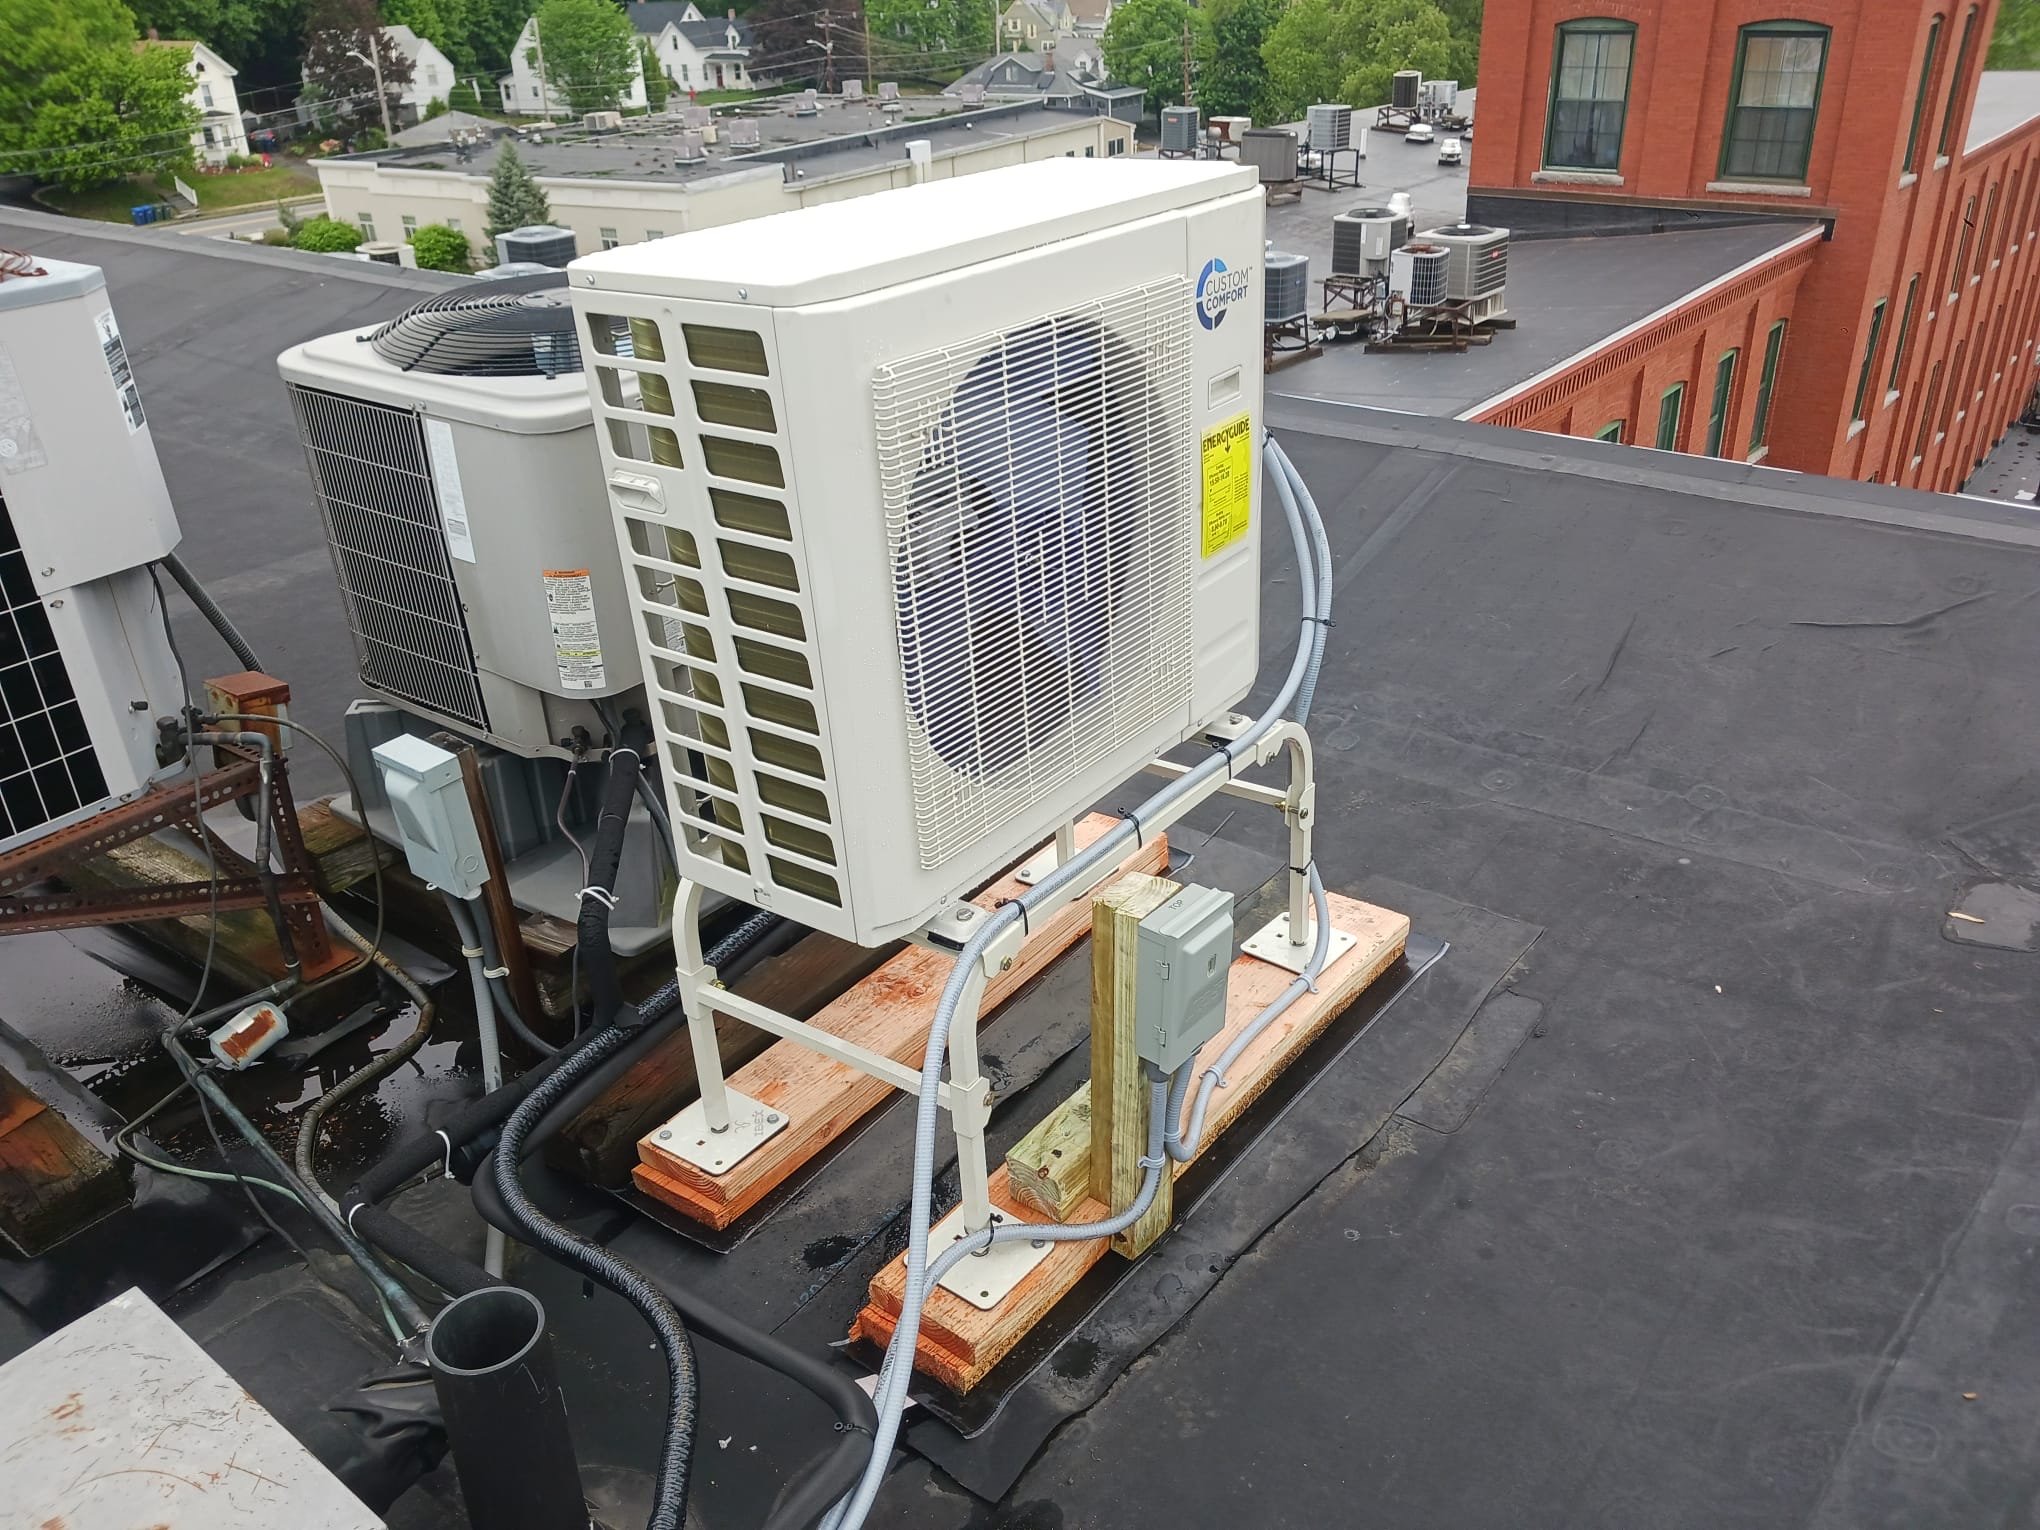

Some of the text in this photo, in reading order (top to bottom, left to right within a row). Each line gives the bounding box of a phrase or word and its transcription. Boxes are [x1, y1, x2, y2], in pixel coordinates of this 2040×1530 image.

[1206, 267, 1249, 296] CUSTOM
[1206, 285, 1248, 311] COMFORT
[1202, 417, 1250, 453] ENERGYGUIDE
[1168, 899, 1183, 910] TOP
